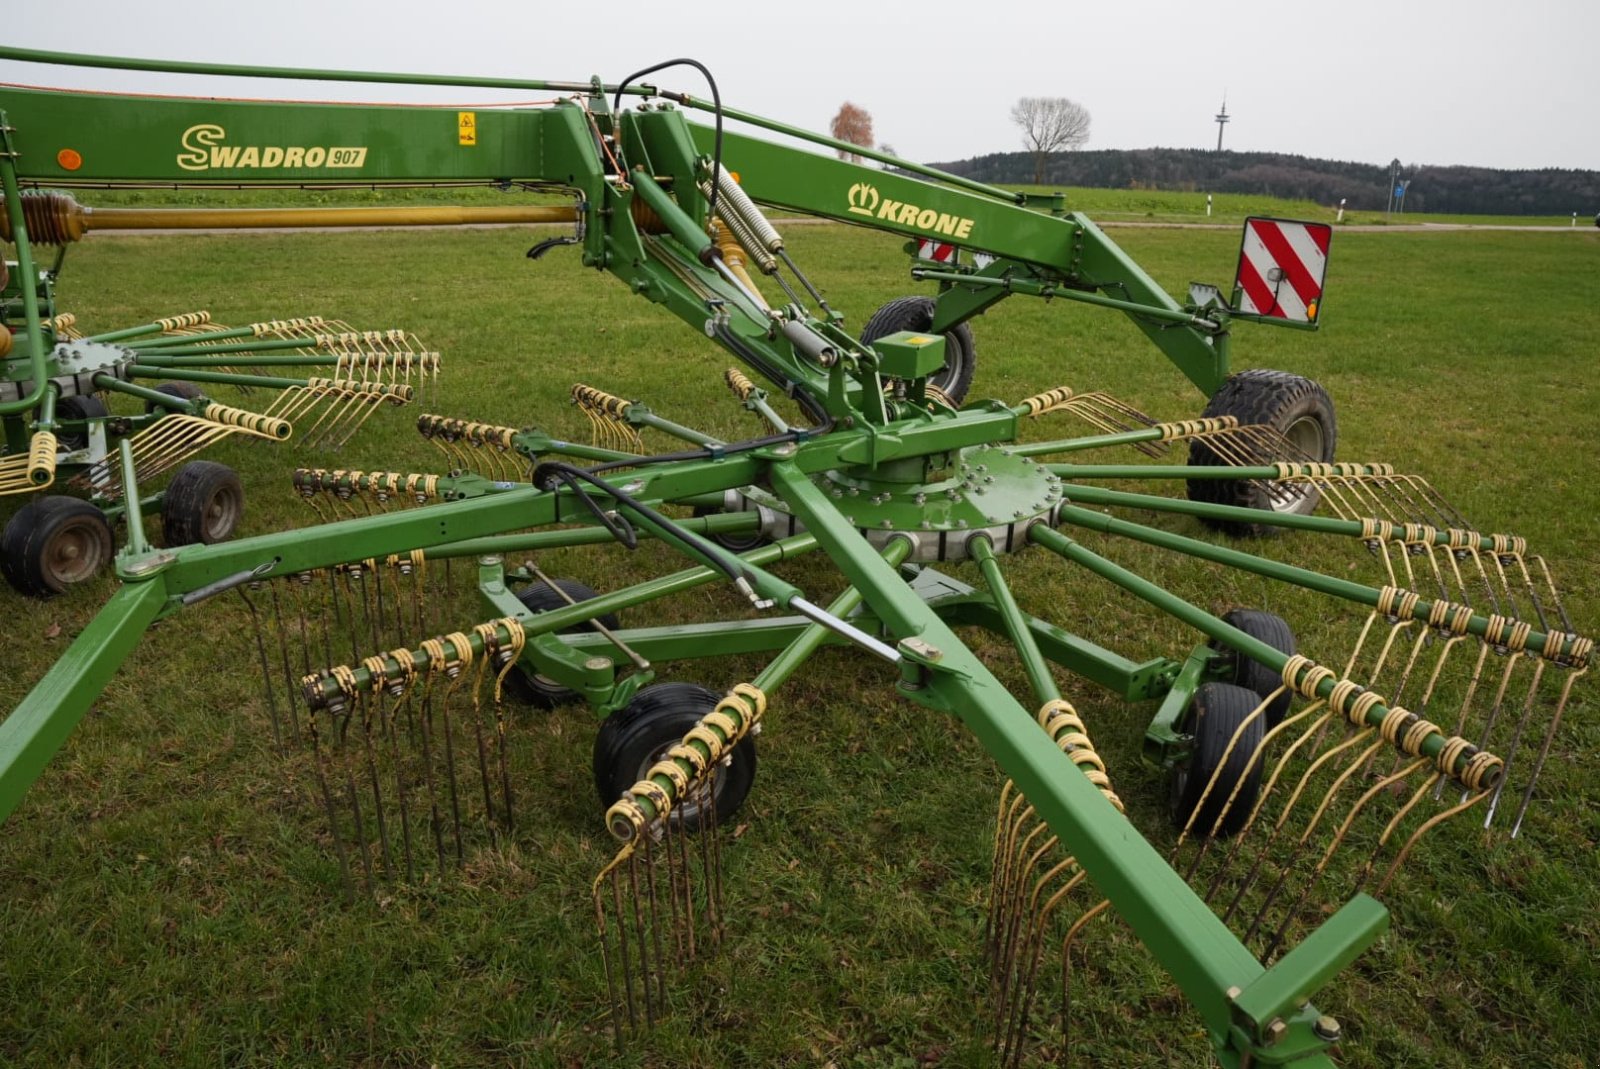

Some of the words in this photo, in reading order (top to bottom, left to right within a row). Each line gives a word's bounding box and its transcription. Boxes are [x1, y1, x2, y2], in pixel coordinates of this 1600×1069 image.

[177, 124, 326, 171] SWADRO
[333, 150, 361, 165] 907
[877, 199, 975, 239] KRONE
